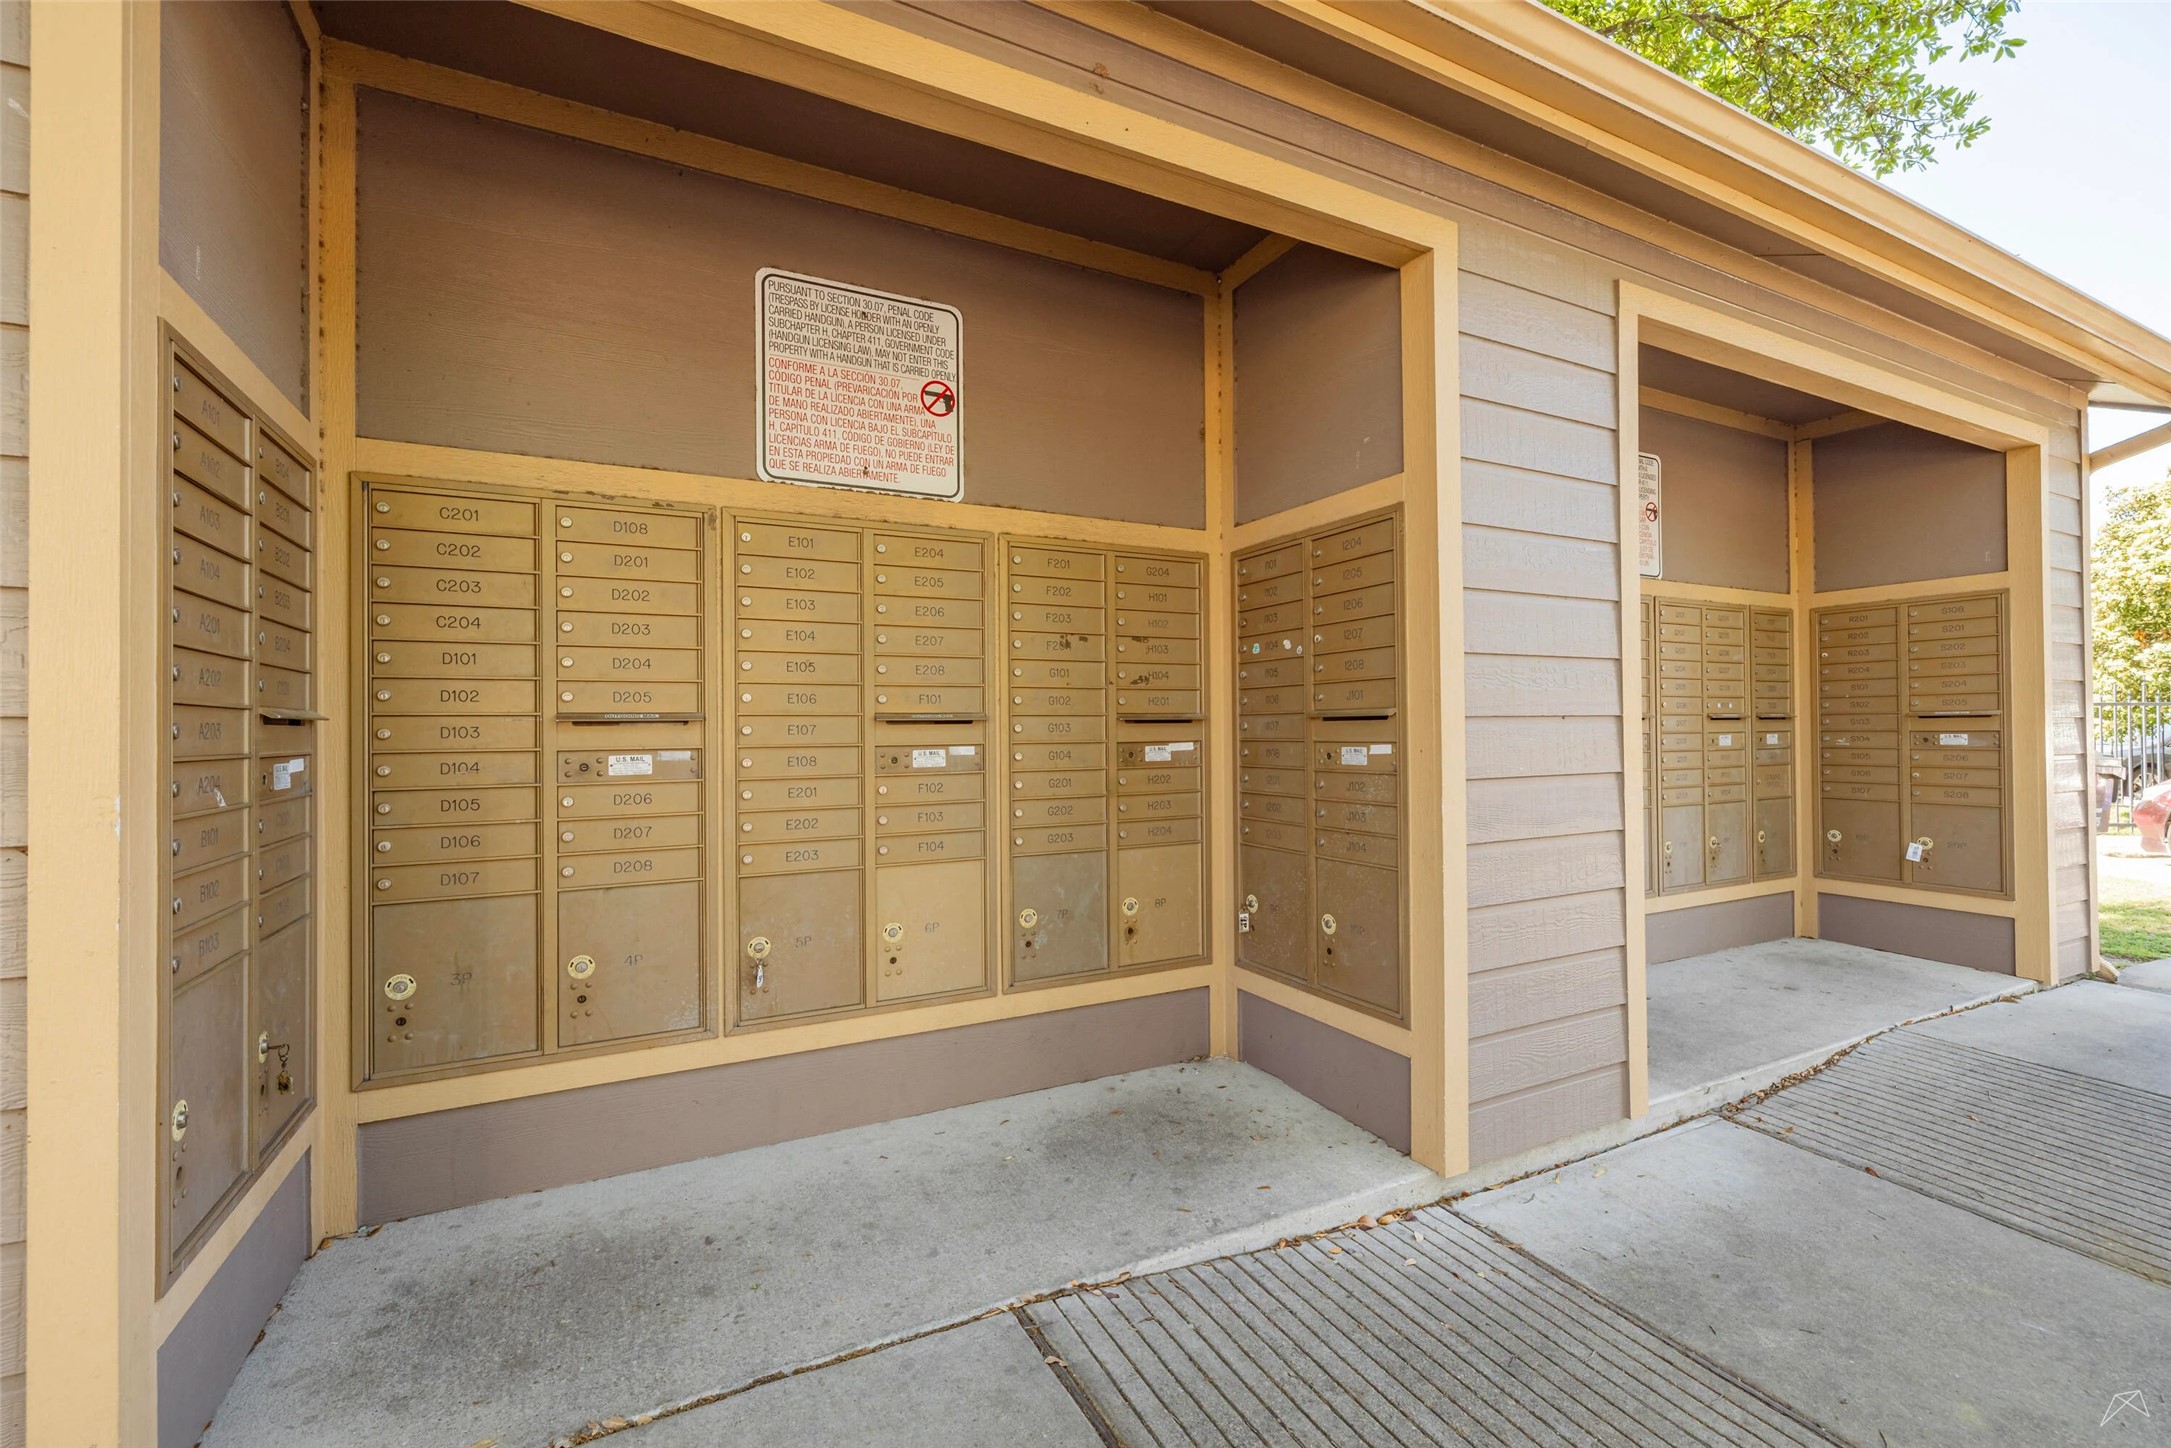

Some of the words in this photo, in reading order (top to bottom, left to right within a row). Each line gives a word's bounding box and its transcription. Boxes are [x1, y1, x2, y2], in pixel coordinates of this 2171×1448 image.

[768, 280, 812, 298] PURSUANT
[814, 289, 825, 300] TO
[826, 291, 860, 307] SECTION
[887, 303, 912, 317] PENAL
[913, 309, 934, 322] CODE
[768, 291, 808, 309] (TRESPASS
[809, 300, 819, 311] BY
[820, 302, 849, 317] LICENSE
[851, 308, 881, 323] HOLDER
[882, 314, 900, 327] WITH
[901, 318, 912, 329] AN
[913, 320, 939, 334] OPENLY
[768, 304, 802, 320] CARRIED
[854, 320, 884, 335] PERSON
[886, 326, 920, 342] LICENSED
[922, 333, 946, 347] UNDER
[768, 316, 820, 335] SUBCHAPTER
[831, 328, 865, 343] CHAPTER
[884, 337, 933, 356] GOVERNMENT
[935, 347, 954, 359] CODE
[768, 328, 810, 345] (HANDGUN
[812, 336, 851, 352] LICENSING
[874, 347, 890, 359] MAY
[892, 350, 907, 362] NOT
[909, 353, 931, 367] ENTER
[932, 358, 948, 369] THIS
[768, 340, 808, 357] PROPERTY
[809, 347, 828, 360] WITH
[836, 352, 872, 368] HANDGUN
[873, 358, 890, 371] THAT
[892, 362, 899, 372] IS
[900, 363, 929, 377] CARRIED
[768, 356, 817, 374] CONFORME
[827, 366, 838, 378] LA
[804, 375, 831, 389] PENAL
[901, 391, 918, 403] POR
[768, 382, 802, 397] TITULAR
[805, 388, 816, 399] DE
[818, 390, 828, 401] LA
[830, 392, 865, 406] LICENCIA
[867, 398, 884, 409] CON
[886, 400, 902, 412] UNA
[903, 403, 925, 415] ARMA
[768, 394, 779, 406] DE
[782, 396, 807, 410] MANO
[810, 401, 854, 417] REALIZADO
[920, 417, 936, 429] UNA
[768, 407, 808, 422] PERSONA
[810, 413, 827, 425] CON
[829, 416, 866, 431] LICENCIA
[867, 422, 888, 434] BAJO
[890, 425, 899, 435] EL
[439, 506, 480, 522] C201
[613, 520, 649, 535] D108
[788, 536, 815, 549] E101
[436, 542, 481, 558] C202
[914, 547, 944, 559] E204
[614, 554, 649, 569] D201
[1047, 558, 1071, 570] F201
[786, 567, 816, 580] E102
[1146, 566, 1170, 577] G204
[436, 578, 482, 594] C203
[914, 576, 944, 589] E205
[611, 588, 650, 602] D202
[1046, 585, 1072, 597] F202
[786, 598, 816, 611] E103
[1148, 593, 1168, 603] H101
[915, 605, 945, 618] E206
[435, 615, 482, 630] C204
[1045, 613, 1072, 624] F203
[611, 622, 651, 635] D203
[786, 629, 816, 642] E104
[915, 635, 945, 647] E207
[1147, 644, 1169, 655] H103
[442, 652, 477, 665] D101
[612, 657, 652, 670] D204
[786, 661, 816, 673] E105
[915, 664, 945, 676] E208
[1049, 668, 1070, 678] G101
[1148, 671, 1170, 680] H104
[440, 689, 480, 703] D102
[612, 691, 652, 704] D205
[787, 692, 817, 705] E106
[918, 694, 942, 705] F101
[1048, 696, 1071, 706] G102
[1148, 697, 1170, 706] H201
[440, 725, 480, 740] D103
[787, 724, 817, 736] E107
[1048, 722, 1071, 733] G103
[787, 755, 817, 768] E108
[1048, 750, 1072, 761] G104
[440, 761, 480, 776] D104
[1048, 778, 1072, 789] G201
[1147, 775, 1172, 785] H202
[787, 786, 817, 799] E201
[918, 782, 944, 794] F102
[440, 798, 481, 813] D105
[613, 792, 653, 806] D206
[1147, 800, 1172, 811] H203
[917, 811, 944, 823] F103
[1047, 806, 1073, 816] G202
[785, 818, 819, 831] E202
[613, 826, 653, 840] D207
[1148, 826, 1173, 837] H204
[440, 834, 481, 850] D106
[1047, 833, 1073, 844] G203
[918, 841, 945, 853] F104
[785, 849, 819, 862] E203
[613, 859, 653, 874] D208
[440, 871, 480, 886] D107
